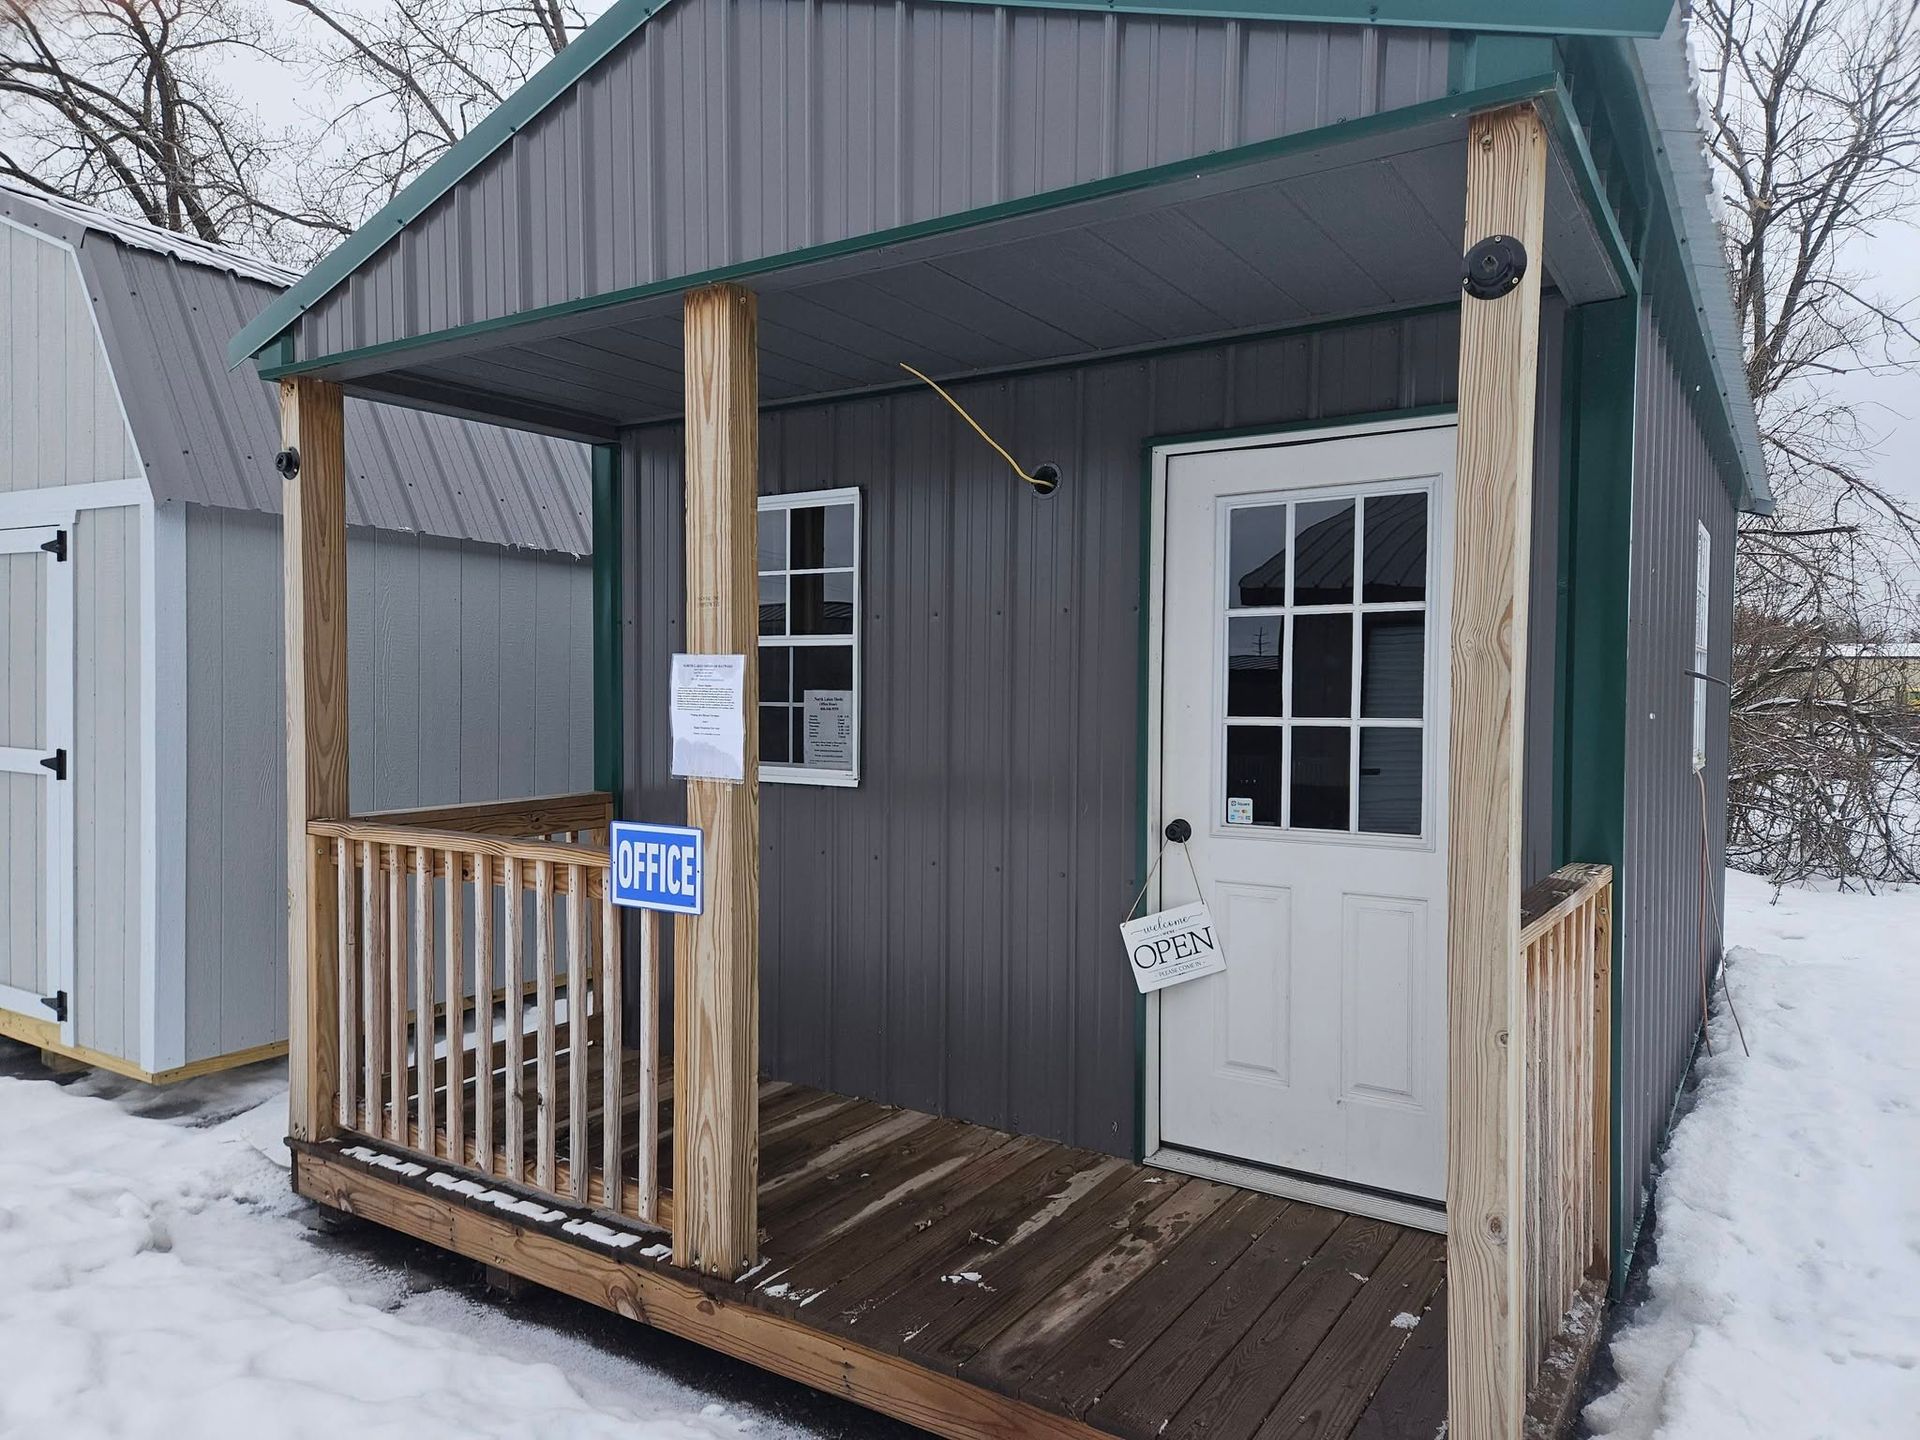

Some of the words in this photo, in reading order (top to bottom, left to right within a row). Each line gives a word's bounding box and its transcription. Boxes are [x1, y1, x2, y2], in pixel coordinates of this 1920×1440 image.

[618, 840, 695, 896] OFFICE
[1142, 915, 1192, 934] welcome
[1133, 926, 1214, 969] OPEN
[1159, 968, 1177, 976] PLEASE
[1178, 962, 1195, 972] COME
